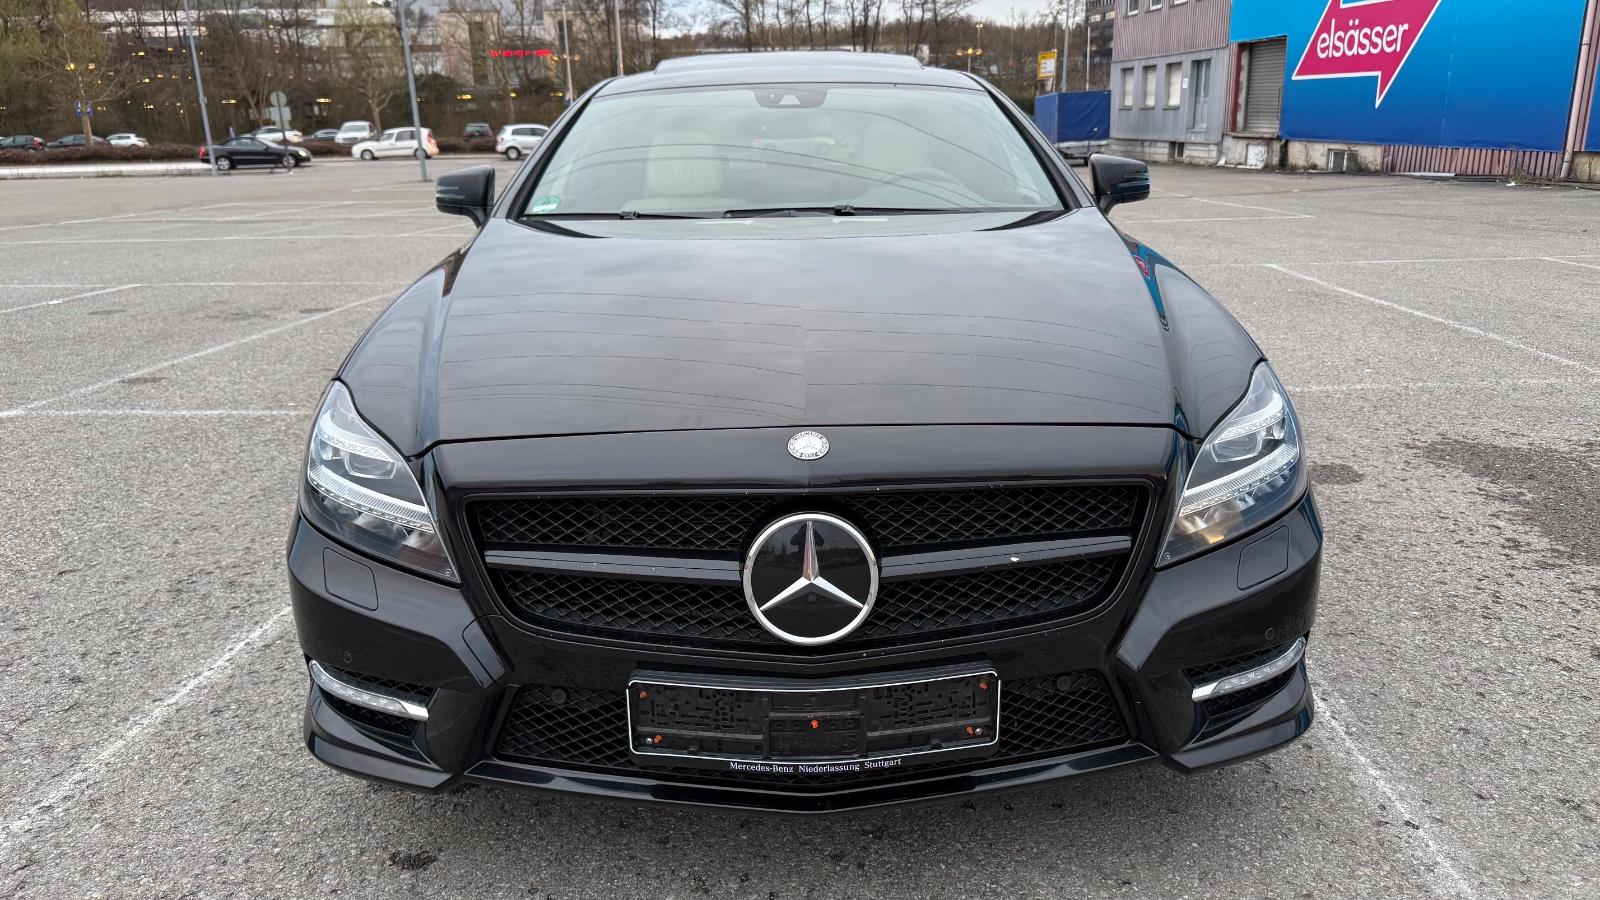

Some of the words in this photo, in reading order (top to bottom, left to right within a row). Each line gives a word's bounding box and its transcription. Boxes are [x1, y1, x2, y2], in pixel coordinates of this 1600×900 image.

[1317, 18, 1408, 59] elsässer
[729, 761, 794, 773] Mercedes-Benz
[798, 763, 860, 773] Niederlassung
[864, 758, 902, 769] Stuttgart
